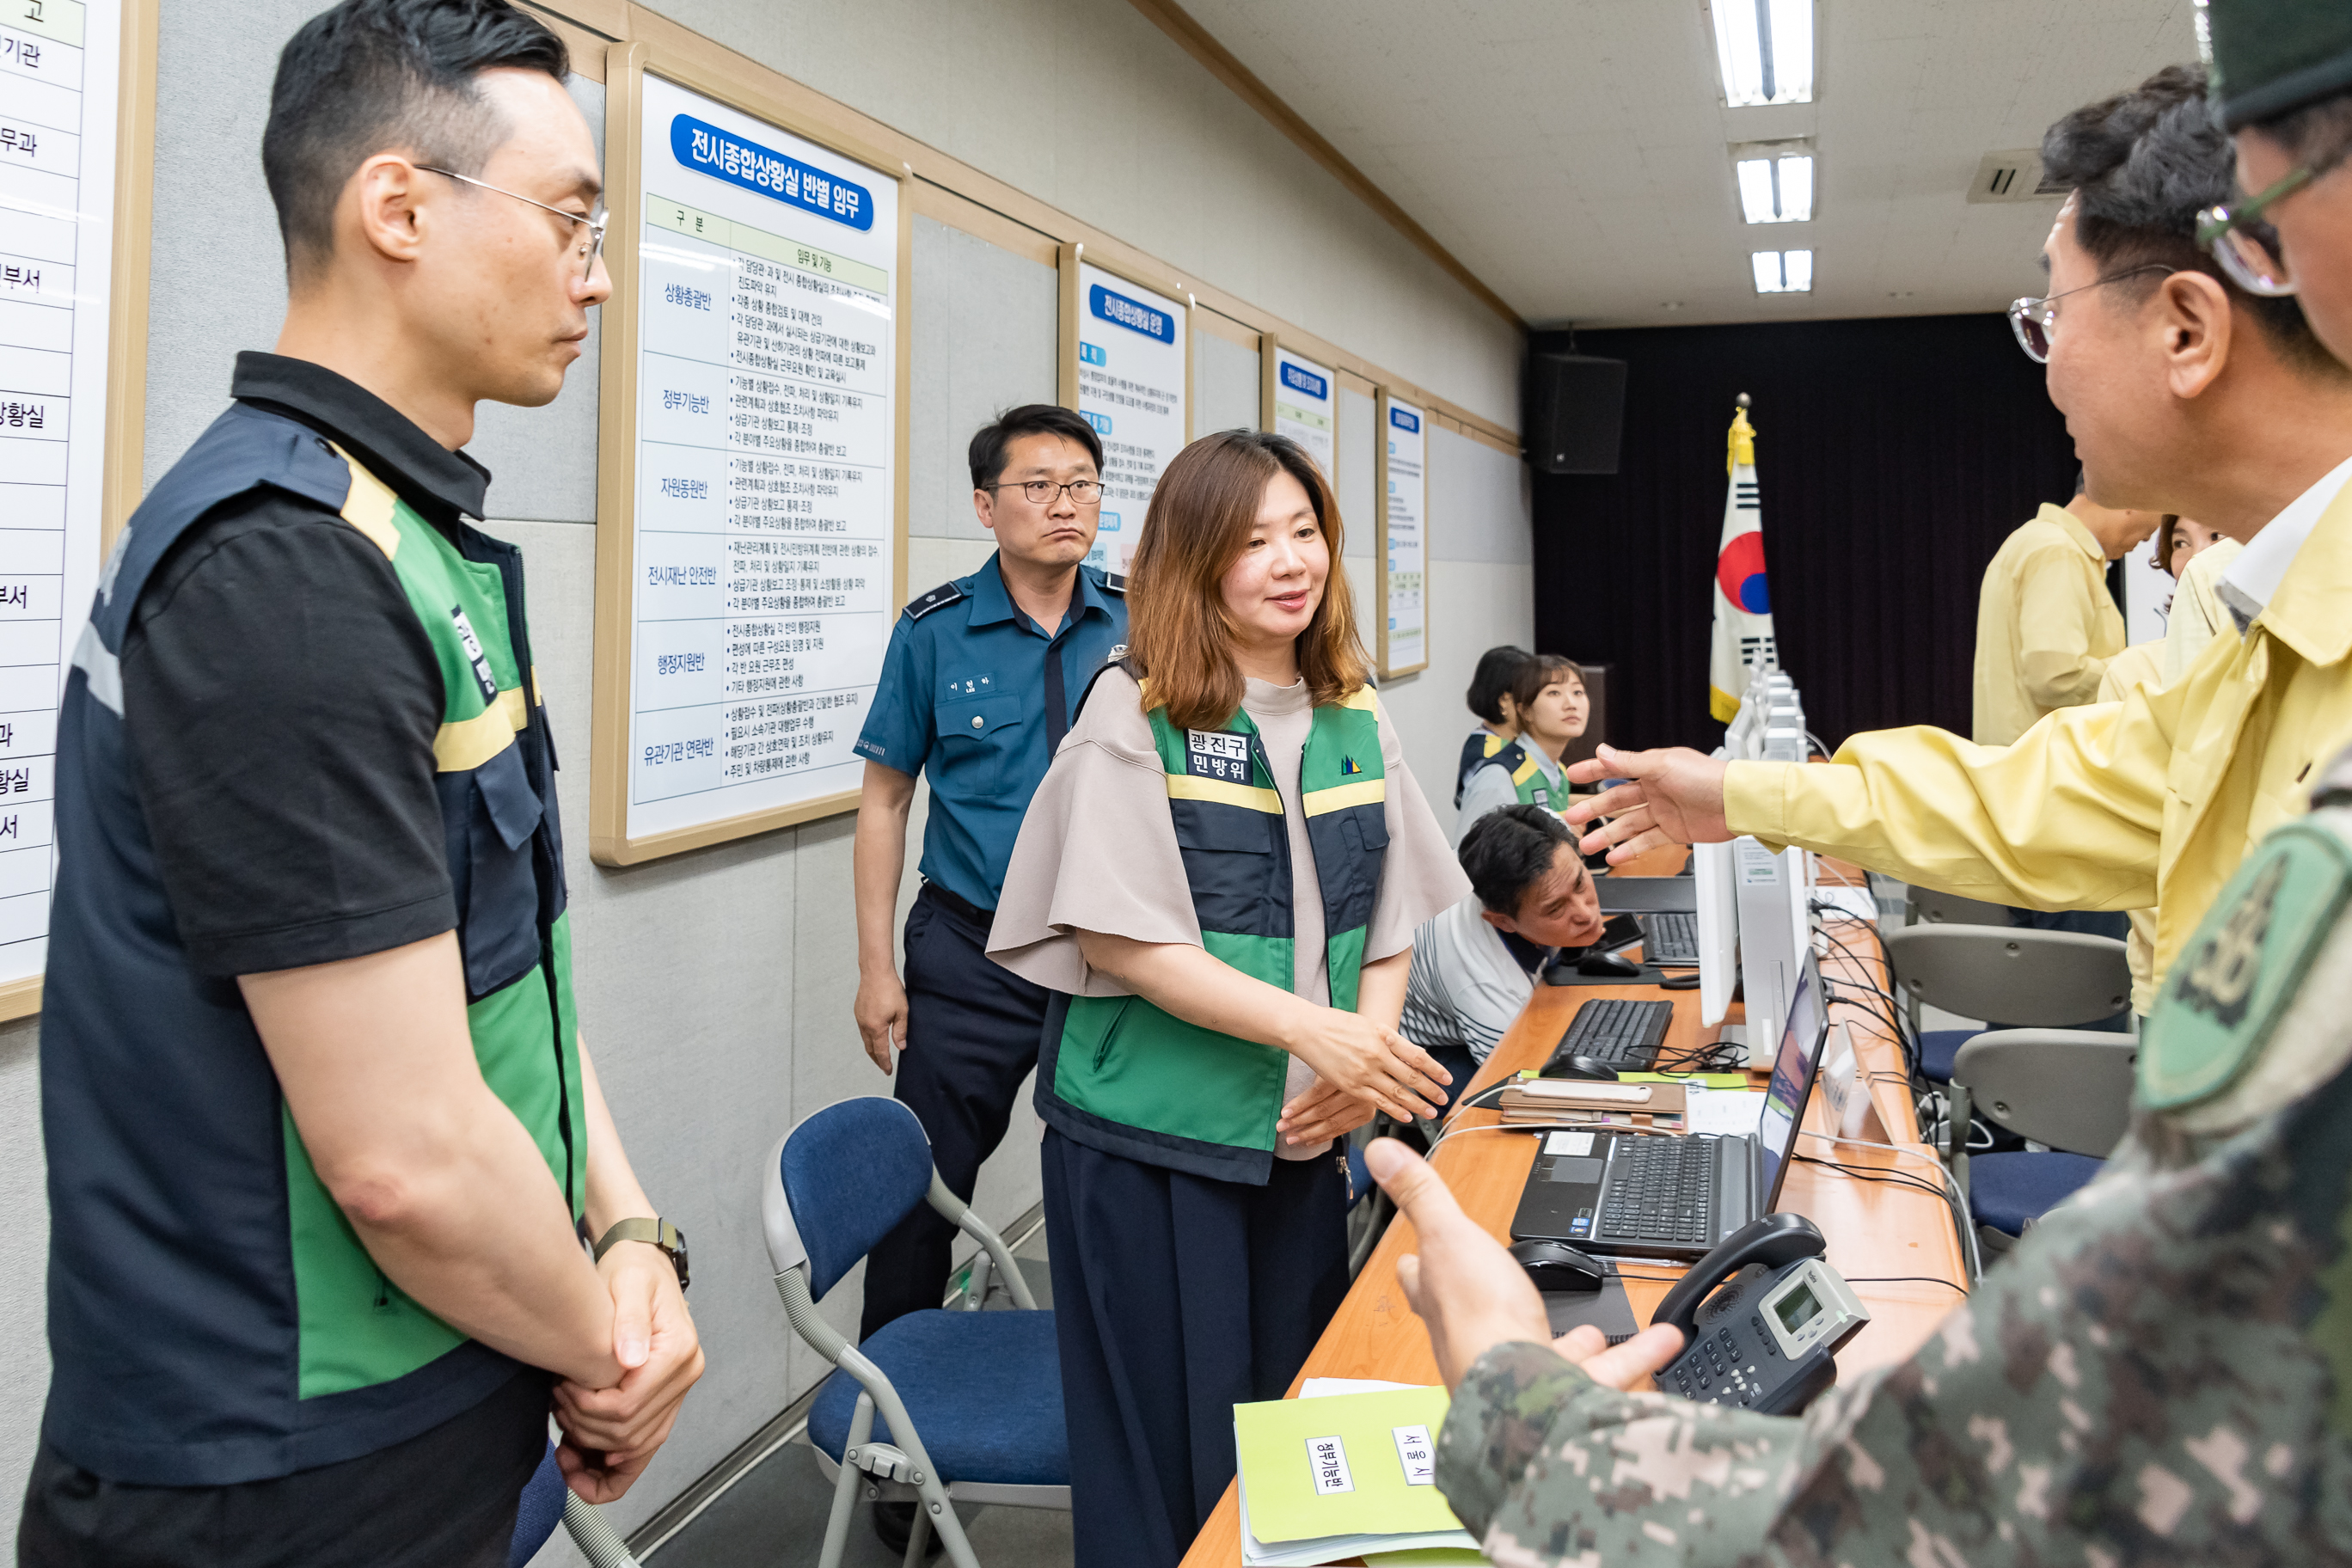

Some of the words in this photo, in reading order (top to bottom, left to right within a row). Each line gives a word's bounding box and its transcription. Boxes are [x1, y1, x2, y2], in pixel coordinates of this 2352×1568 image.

[0, 35, 40, 68] 기관
[691, 128, 799, 198] 전시종합상황실
[803, 173, 830, 209] 반별
[833, 185, 859, 219] 임무
[798, 248, 811, 266] 임무
[819, 255, 832, 273] 기능
[0, 263, 40, 293] 부서
[738, 275, 763, 294] 진도파악
[665, 283, 711, 311] 상황총괄반
[737, 294, 750, 309] 각종
[751, 298, 763, 313] 상황
[737, 331, 762, 349] 유관기관
[735, 376, 754, 391] 기능별
[663, 389, 709, 414] 정부기능반
[734, 413, 760, 429] 상급기관
[742, 432, 761, 448] 분야별
[735, 458, 754, 473] 기능별
[661, 478, 707, 499] 자원동원반
[734, 495, 760, 510] 상급기관
[742, 515, 761, 529] 분야별
[648, 566, 687, 585] 전시재난
[689, 567, 716, 585] 안전반
[732, 578, 758, 592] 상급기관
[741, 597, 760, 610] 분야별
[732, 642, 751, 657] 편성에
[658, 652, 704, 675] 행정지원반
[731, 680, 744, 694] 기타
[731, 706, 756, 722] 상황접수
[731, 725, 750, 741] 필요시
[644, 742, 683, 766] 유관기관
[685, 737, 714, 759] 연락반
[730, 743, 756, 759] 해당기관
[1191, 733, 1246, 756] 광진구
[730, 763, 743, 778] 주민
[1193, 754, 1246, 781] 민방위
[1317, 1443, 1344, 1487] 정부기능반
